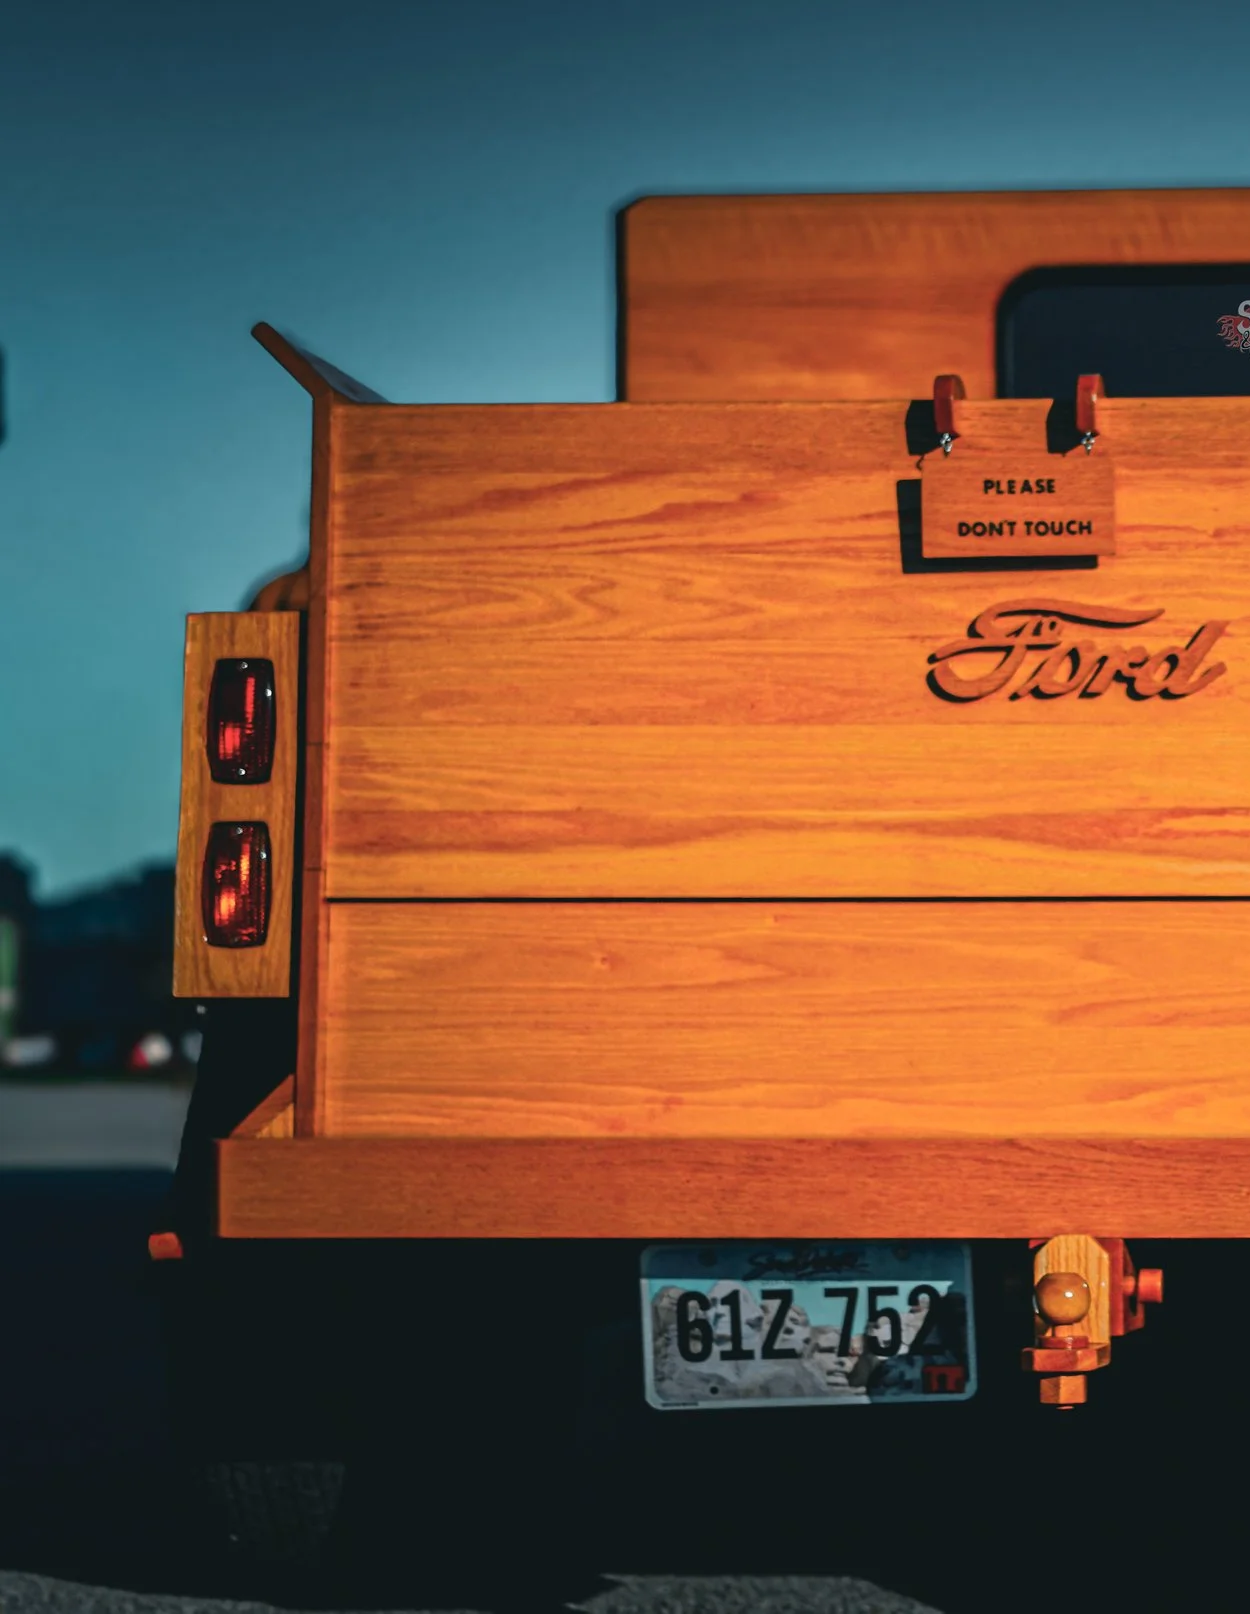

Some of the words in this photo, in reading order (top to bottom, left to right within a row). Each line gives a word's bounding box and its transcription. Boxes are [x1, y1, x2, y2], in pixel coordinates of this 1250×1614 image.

[983, 479, 1056, 495] PLEASE
[1024, 520, 1093, 536] TOUCH
[926, 597, 1230, 704] Ford
[676, 1288, 801, 1363] 61Z
[824, 1284, 949, 1358] 752
